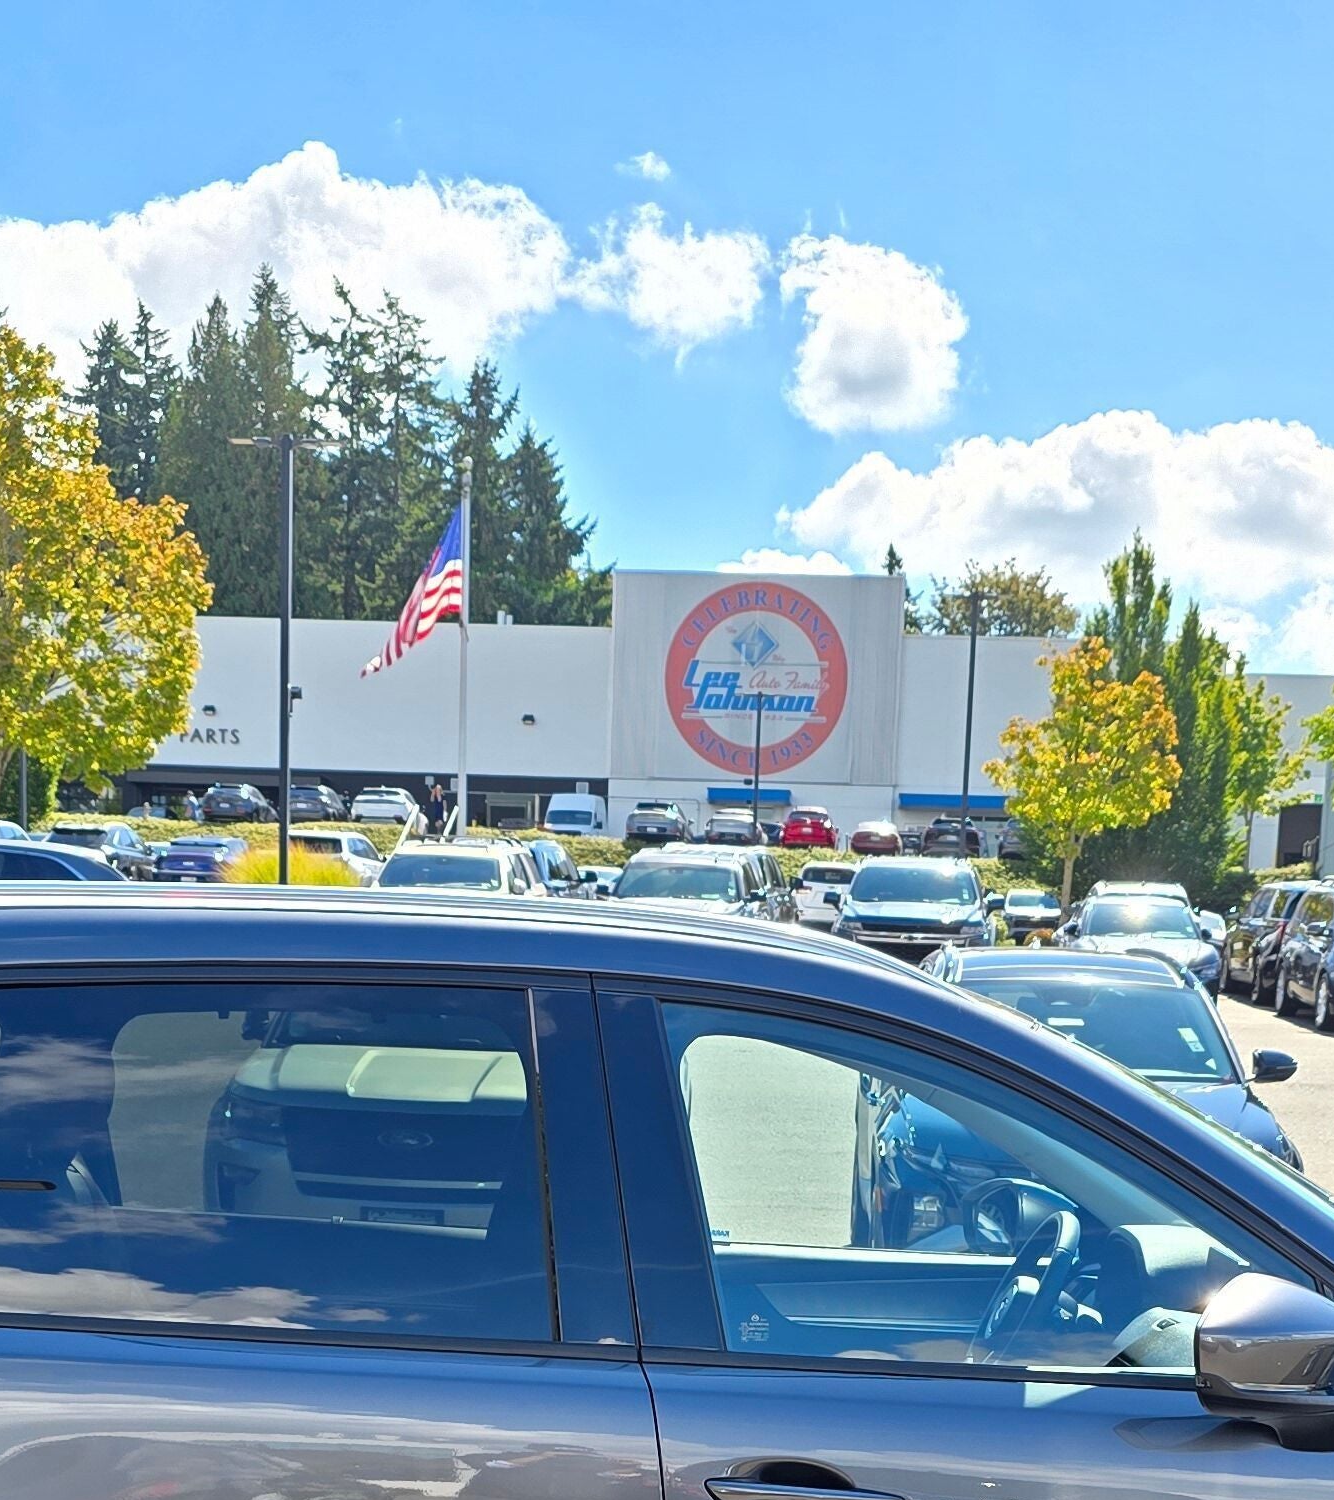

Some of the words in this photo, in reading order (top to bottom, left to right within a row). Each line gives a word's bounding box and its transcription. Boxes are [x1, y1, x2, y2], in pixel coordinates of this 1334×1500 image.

[682, 590, 833, 650] CELEBRATING
[683, 659, 743, 689] Lee
[749, 670, 782, 690] Auto
[784, 671, 830, 698] Family
[771, 732, 814, 766] 1933
